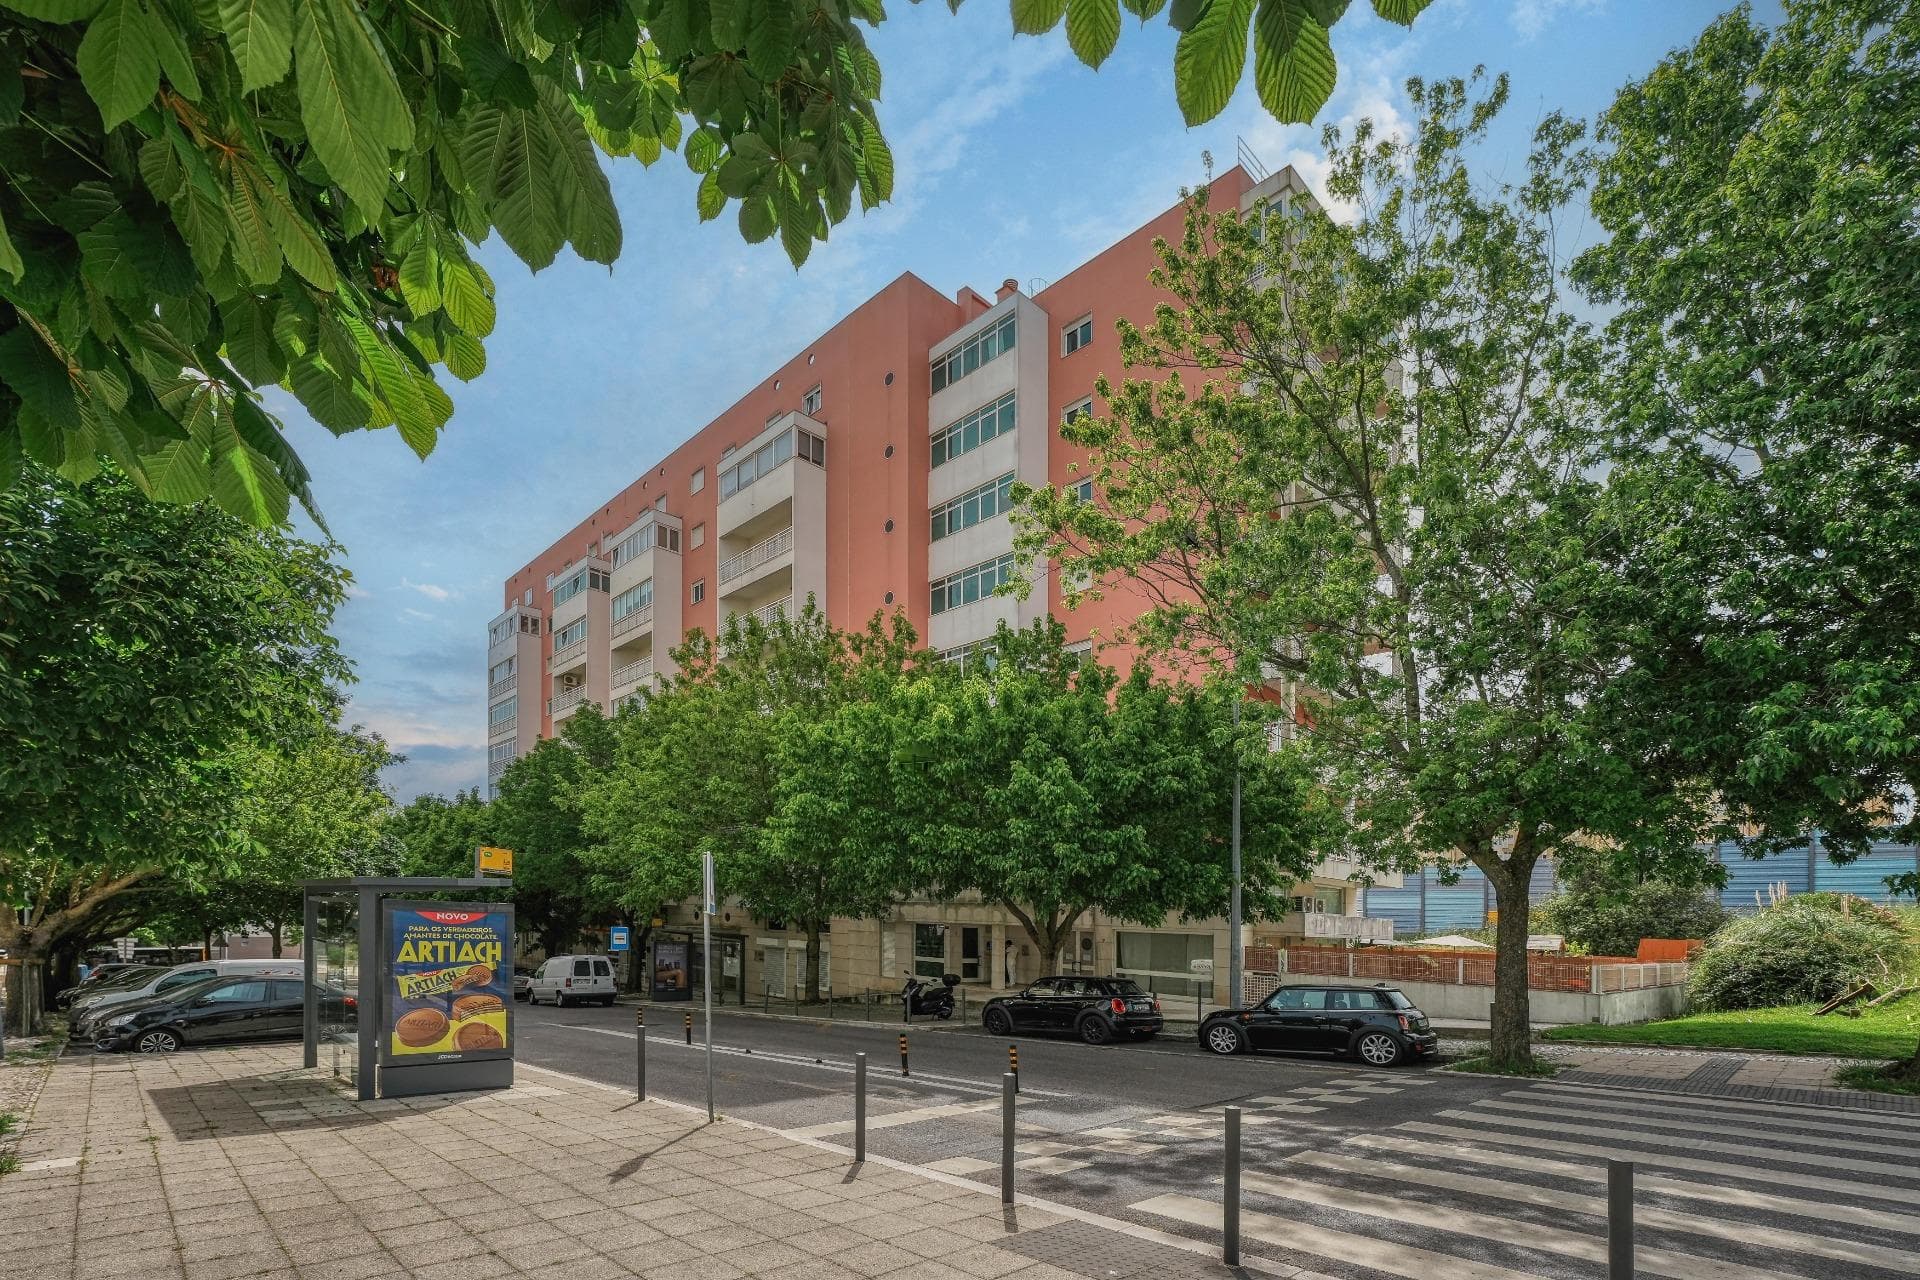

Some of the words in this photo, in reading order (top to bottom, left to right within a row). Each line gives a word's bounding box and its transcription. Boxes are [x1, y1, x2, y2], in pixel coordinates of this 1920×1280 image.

[436, 912, 469, 920] NOVO
[403, 932, 441, 940] AMANTES
[396, 940, 502, 963] ARTIACH
[407, 970, 456, 995] ARTIACH
